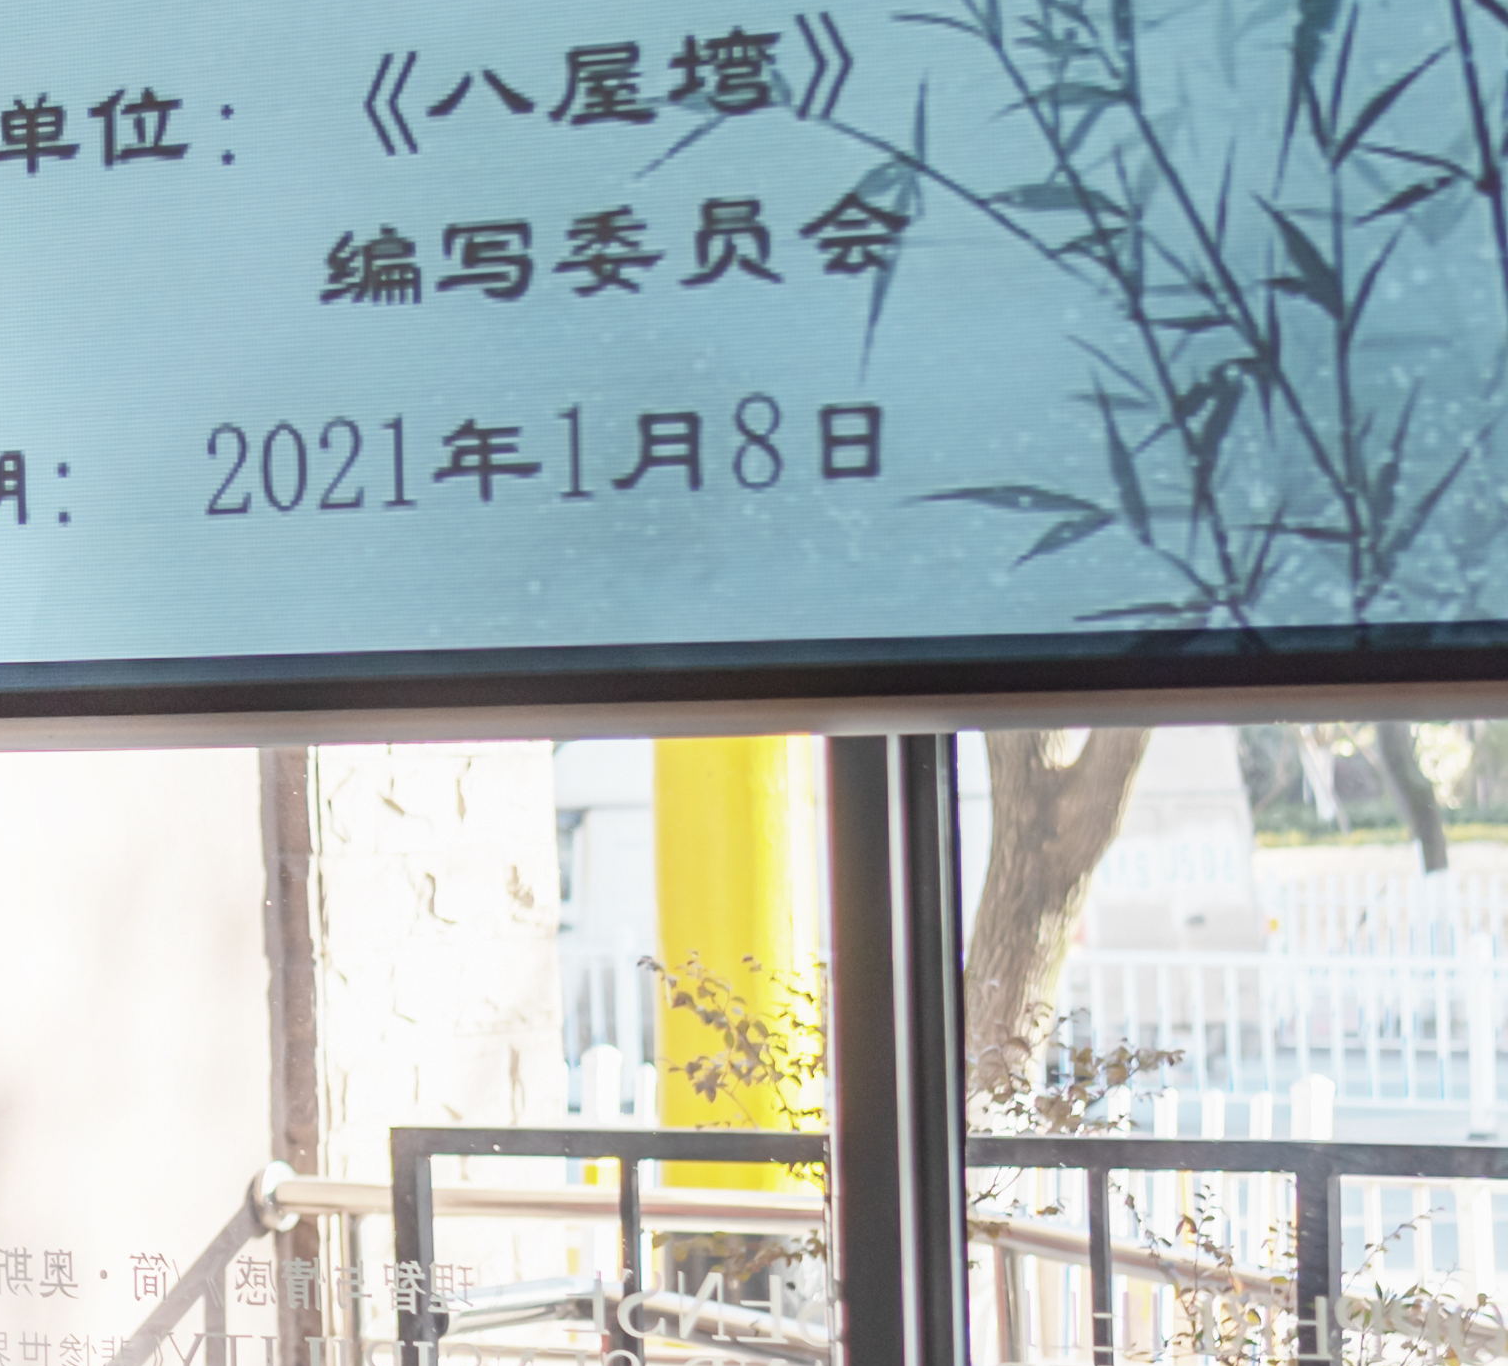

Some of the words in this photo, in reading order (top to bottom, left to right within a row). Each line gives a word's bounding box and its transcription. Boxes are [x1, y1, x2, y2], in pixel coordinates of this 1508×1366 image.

[319, 190, 914, 306] 编写委员会
[203, 389, 884, 518] 2021年1月8日
